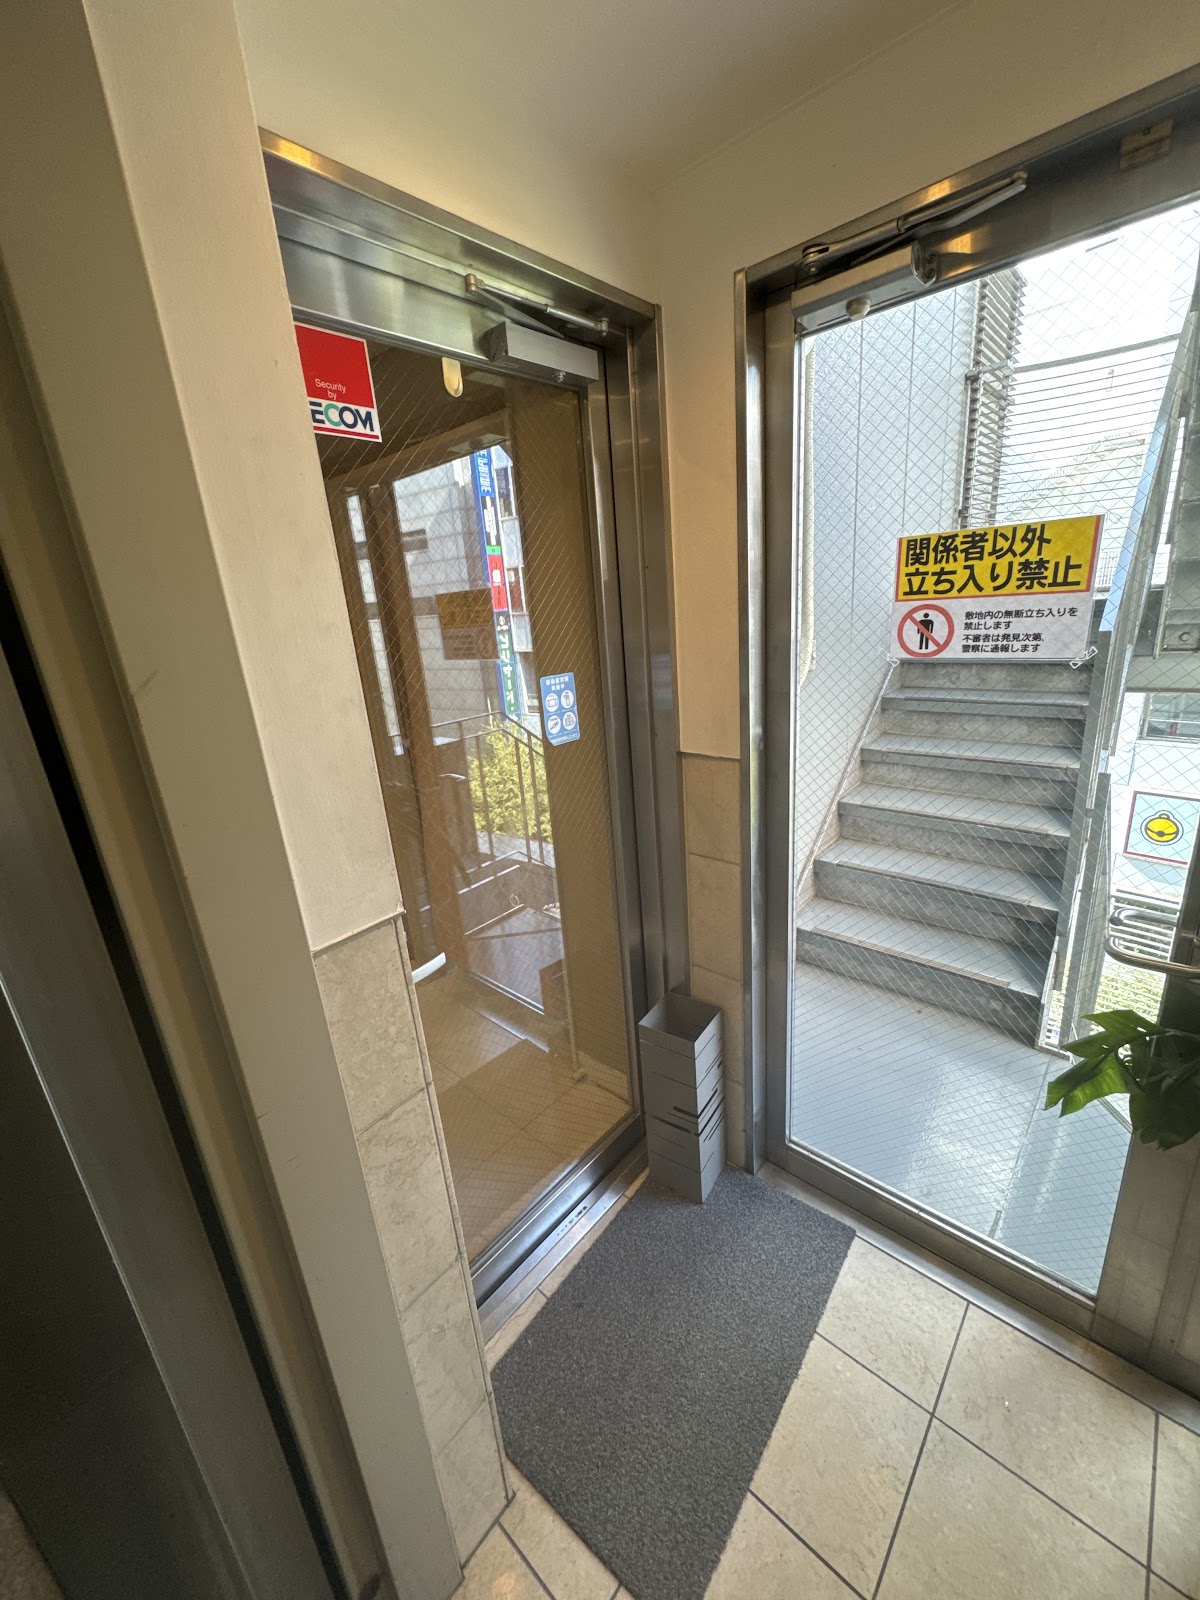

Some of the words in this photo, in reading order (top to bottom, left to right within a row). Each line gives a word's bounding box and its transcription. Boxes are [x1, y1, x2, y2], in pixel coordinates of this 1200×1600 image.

[315, 378, 346, 394] Security
[327, 390, 337, 400] by
[905, 524, 1052, 567] 関係者以外
[903, 555, 1082, 596] 立ち入り禁止
[964, 607, 1079, 620] 敷地内の無断立ち入りを
[963, 621, 1013, 630] 禁止します
[961, 644, 1041, 653] 警察に通報します
